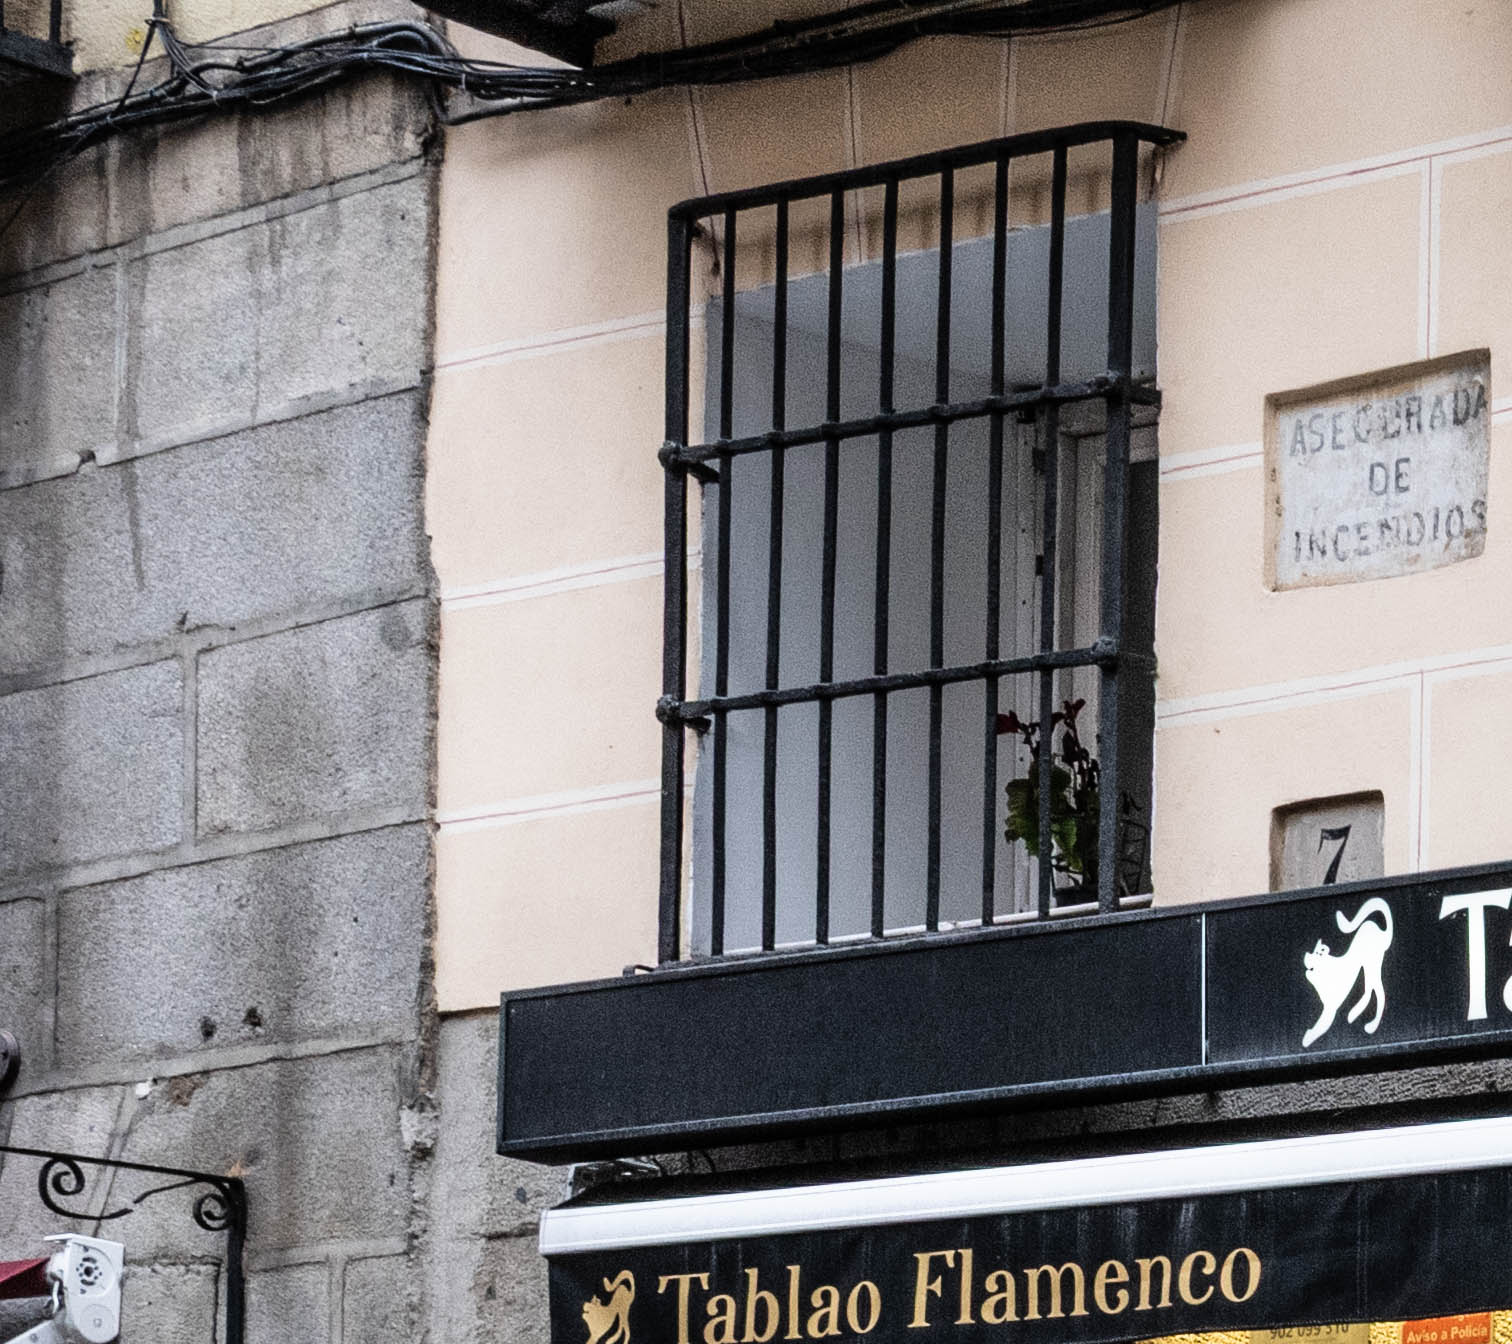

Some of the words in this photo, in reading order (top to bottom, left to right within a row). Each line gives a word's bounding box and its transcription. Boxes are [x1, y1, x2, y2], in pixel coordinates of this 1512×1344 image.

[1368, 457, 1411, 496] DE
[1293, 499, 1487, 562] INCENDIOS
[1317, 823, 1352, 885] 7
[909, 1247, 1263, 1330] Flamenco
[1406, 1329, 1438, 1344] Aviso
[1441, 1330, 1448, 1341] a
